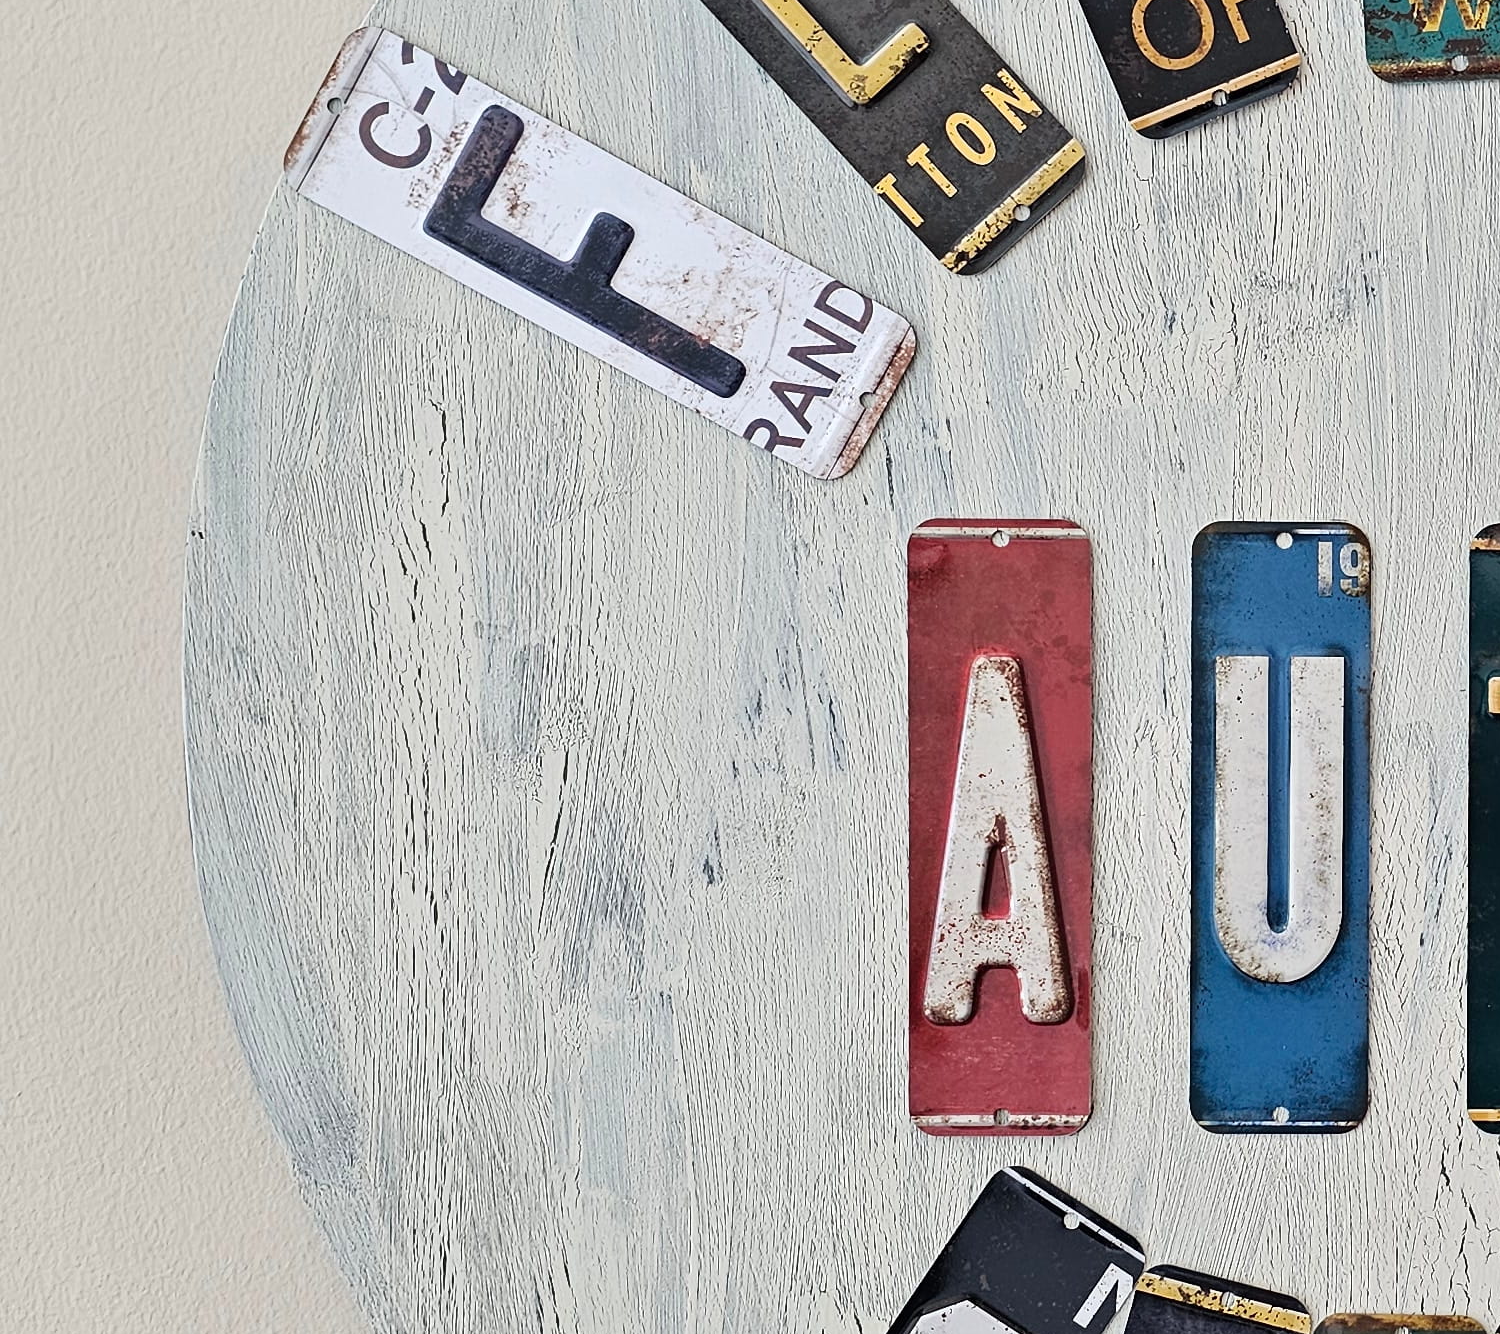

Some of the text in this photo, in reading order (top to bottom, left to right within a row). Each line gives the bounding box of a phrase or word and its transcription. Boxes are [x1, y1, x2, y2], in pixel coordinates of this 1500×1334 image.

[875, 69, 1043, 228] TTON
[743, 280, 873, 453] RAND
[1317, 541, 1369, 597] 19
